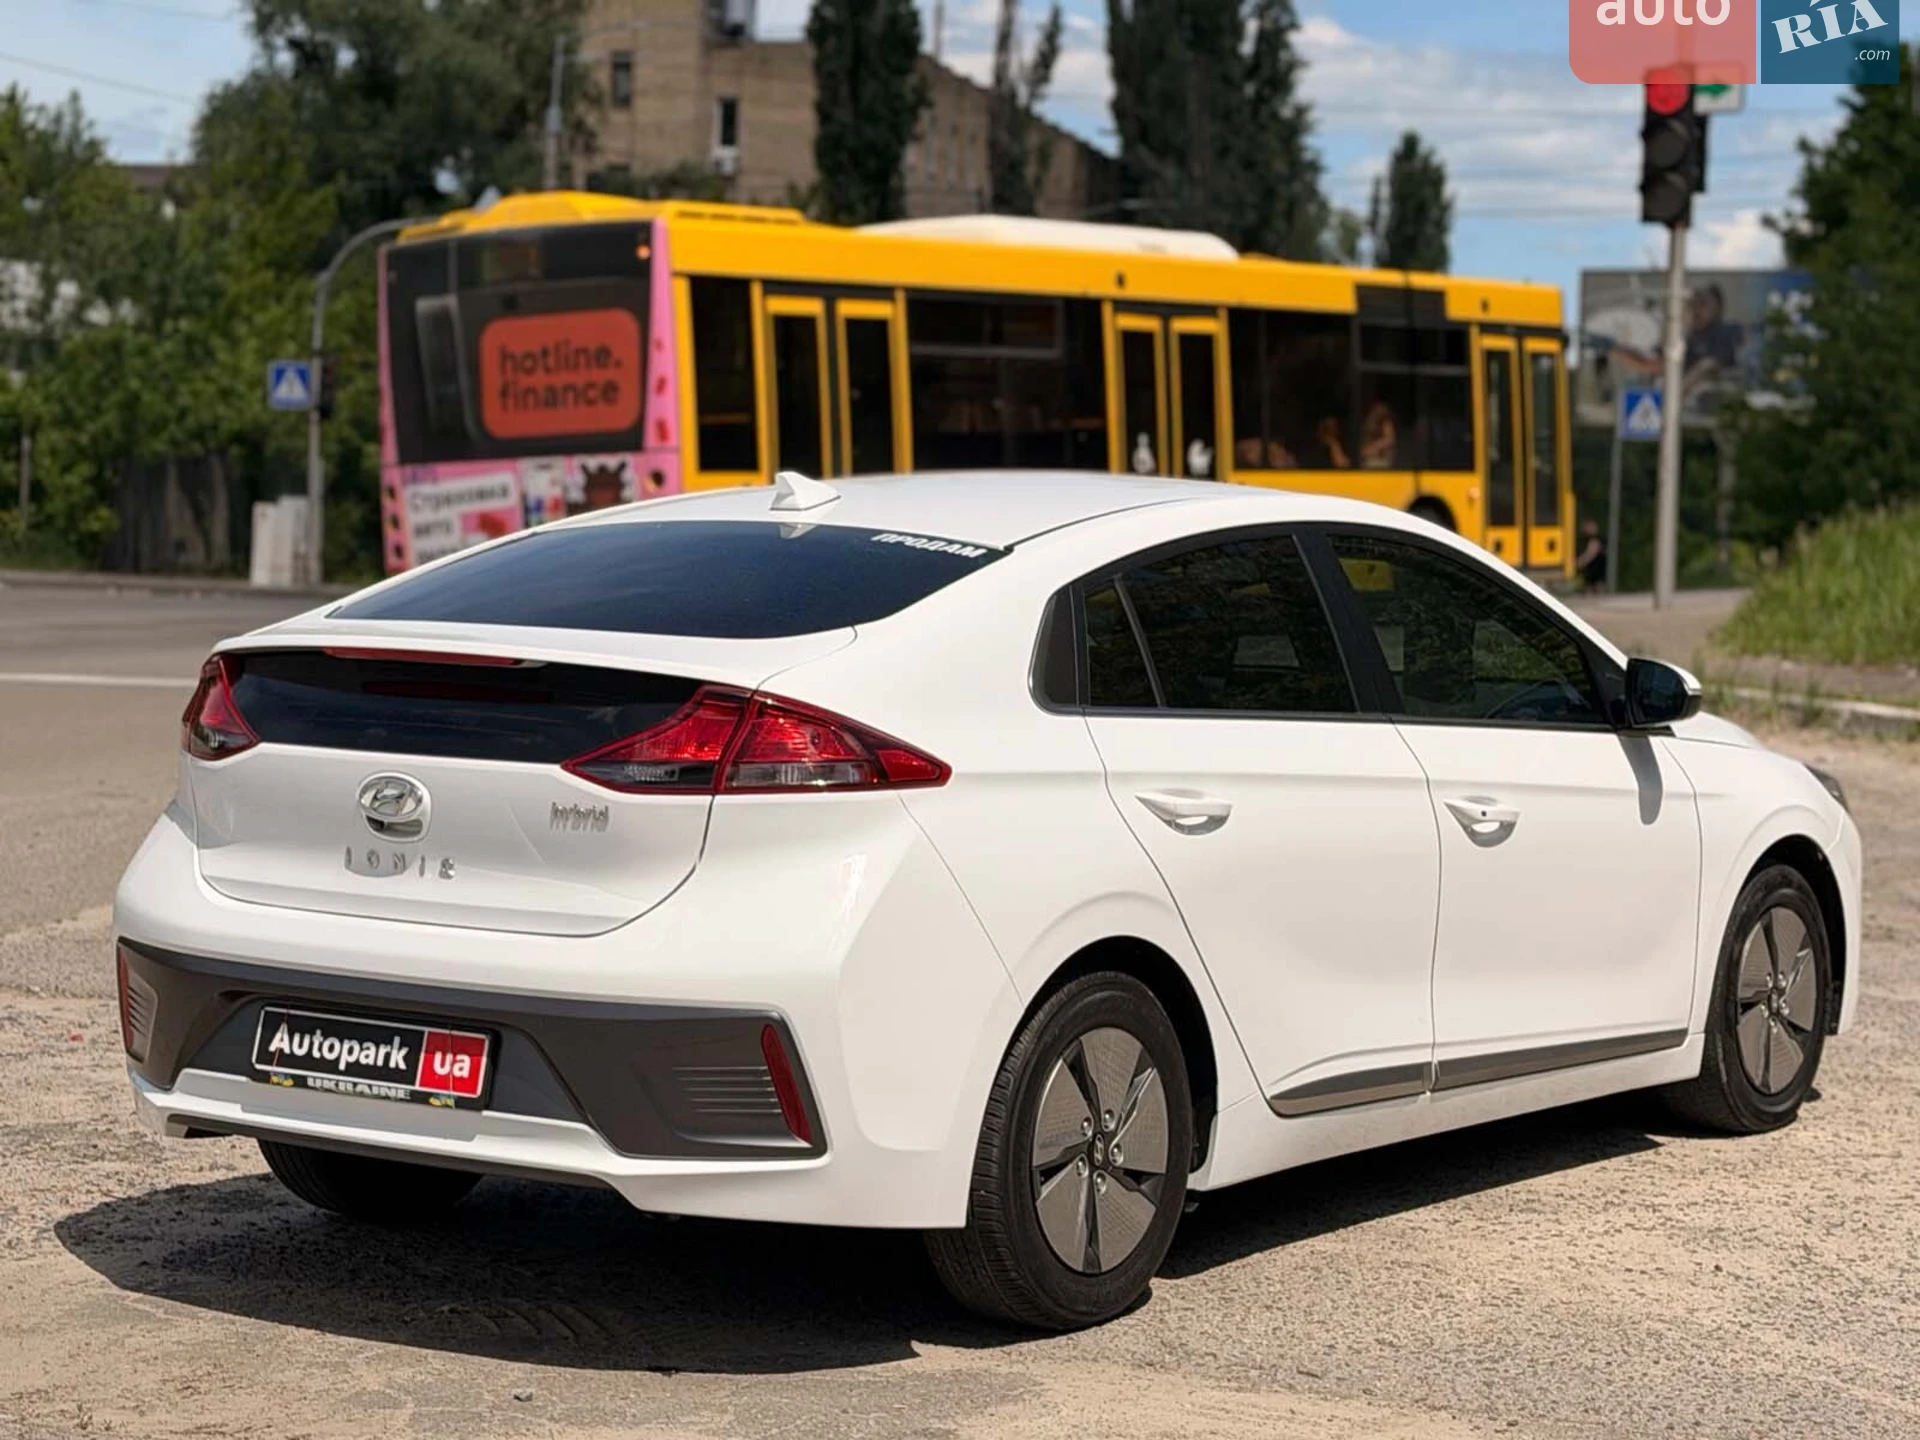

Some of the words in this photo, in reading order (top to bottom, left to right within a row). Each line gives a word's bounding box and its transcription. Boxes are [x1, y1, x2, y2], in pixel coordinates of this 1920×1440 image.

[499, 340, 623, 375] hotline.
[499, 380, 620, 412] finance
[870, 533, 988, 558] ПРОДАМ
[550, 802, 610, 830] hybrid
[268, 1022, 410, 1071] Autopark
[432, 1050, 471, 1078] ua
[306, 1076, 411, 1100] UKRAINE
